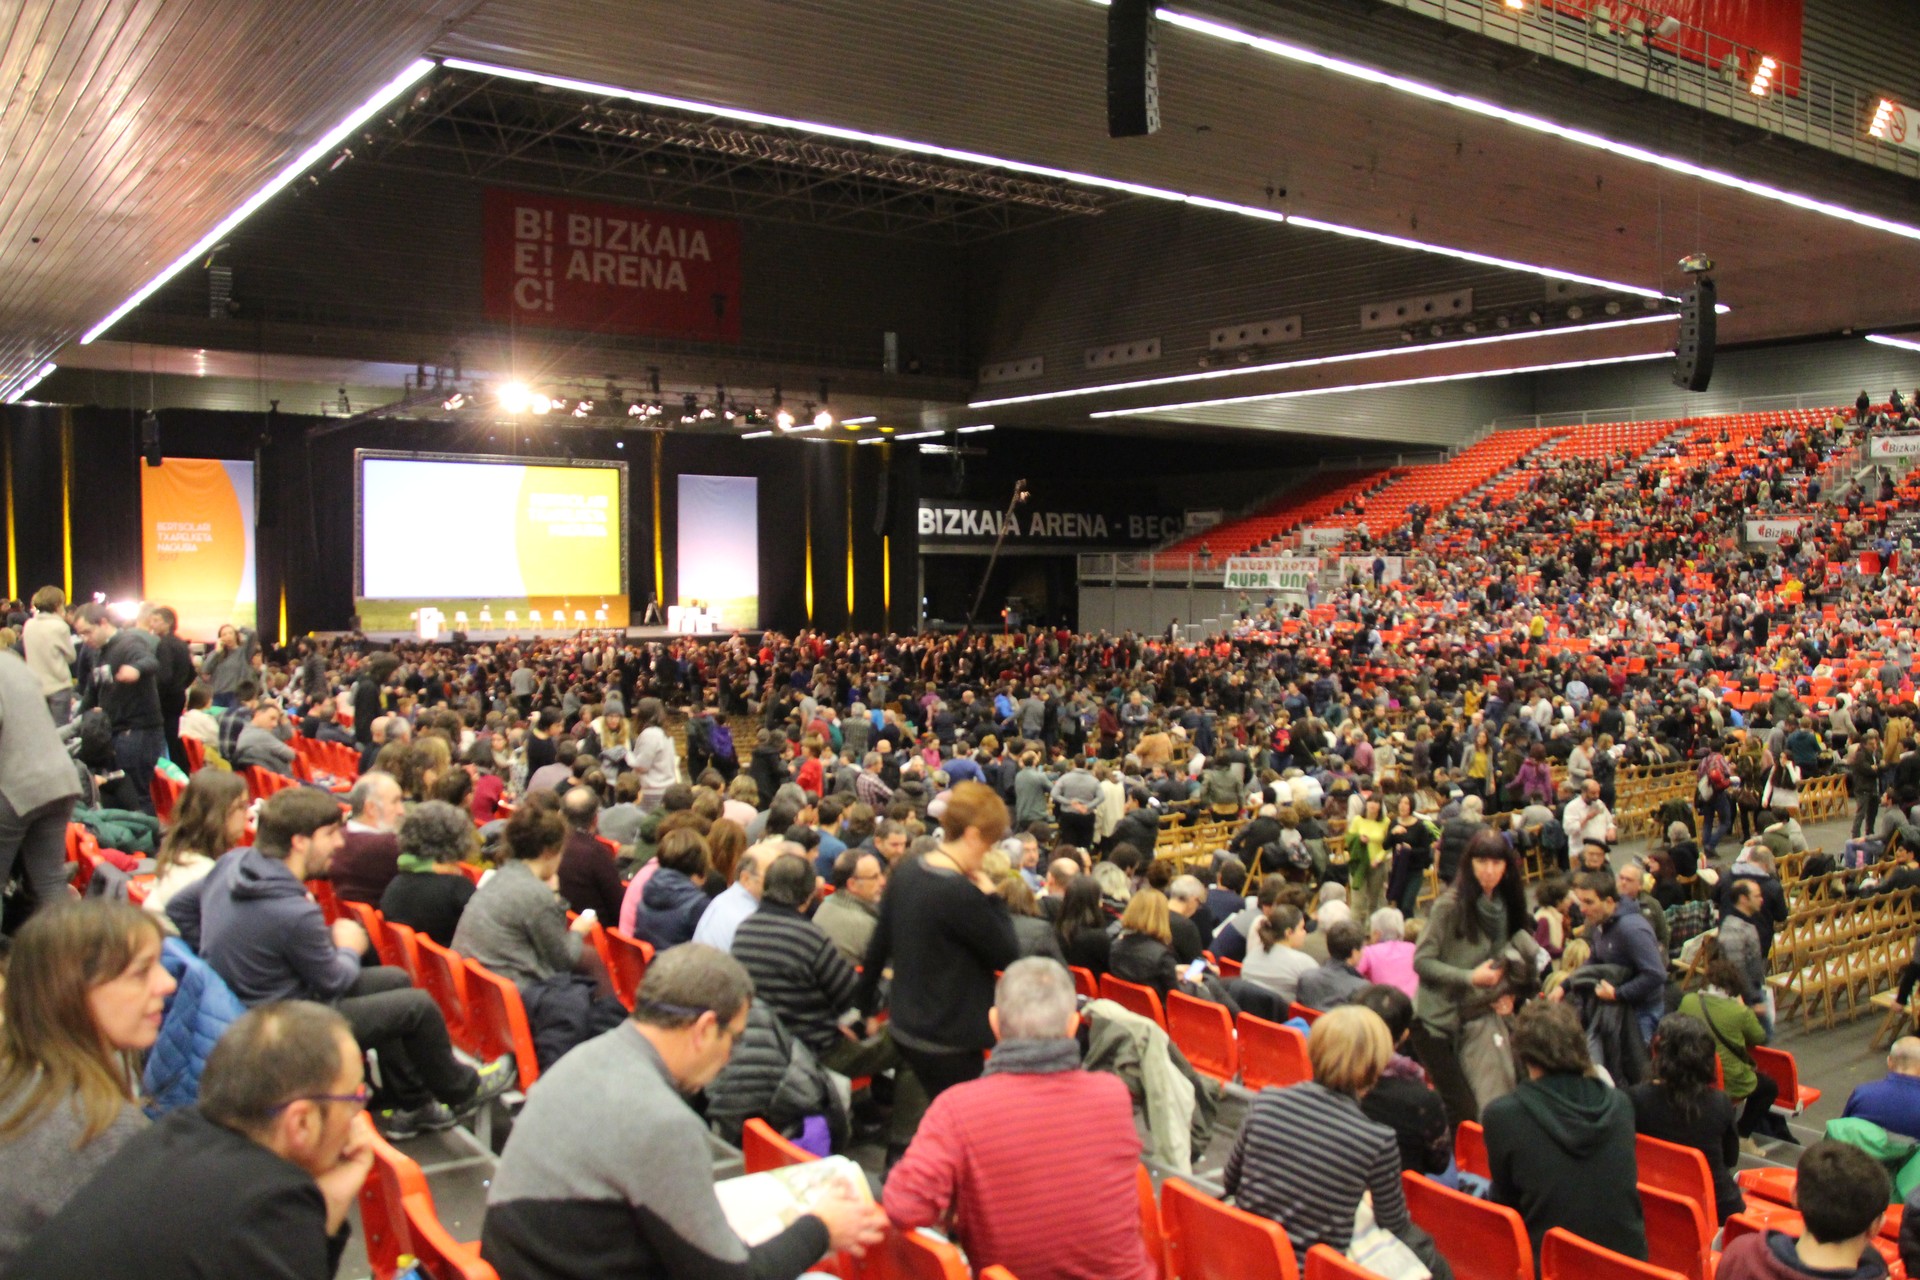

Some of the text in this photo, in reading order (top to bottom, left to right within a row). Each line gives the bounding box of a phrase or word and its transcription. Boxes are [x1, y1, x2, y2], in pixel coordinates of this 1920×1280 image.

[514, 206, 554, 242] B!
[567, 213, 712, 262] BIZKAIA
[514, 242, 553, 277] E!
[565, 249, 688, 292] ARENA
[513, 277, 555, 312] C!
[1889, 441, 1920, 453] Bizkai
[918, 507, 1021, 536] BIZKAIA
[1029, 511, 1109, 538] ARENA
[1228, 572, 1268, 587] AUPA
